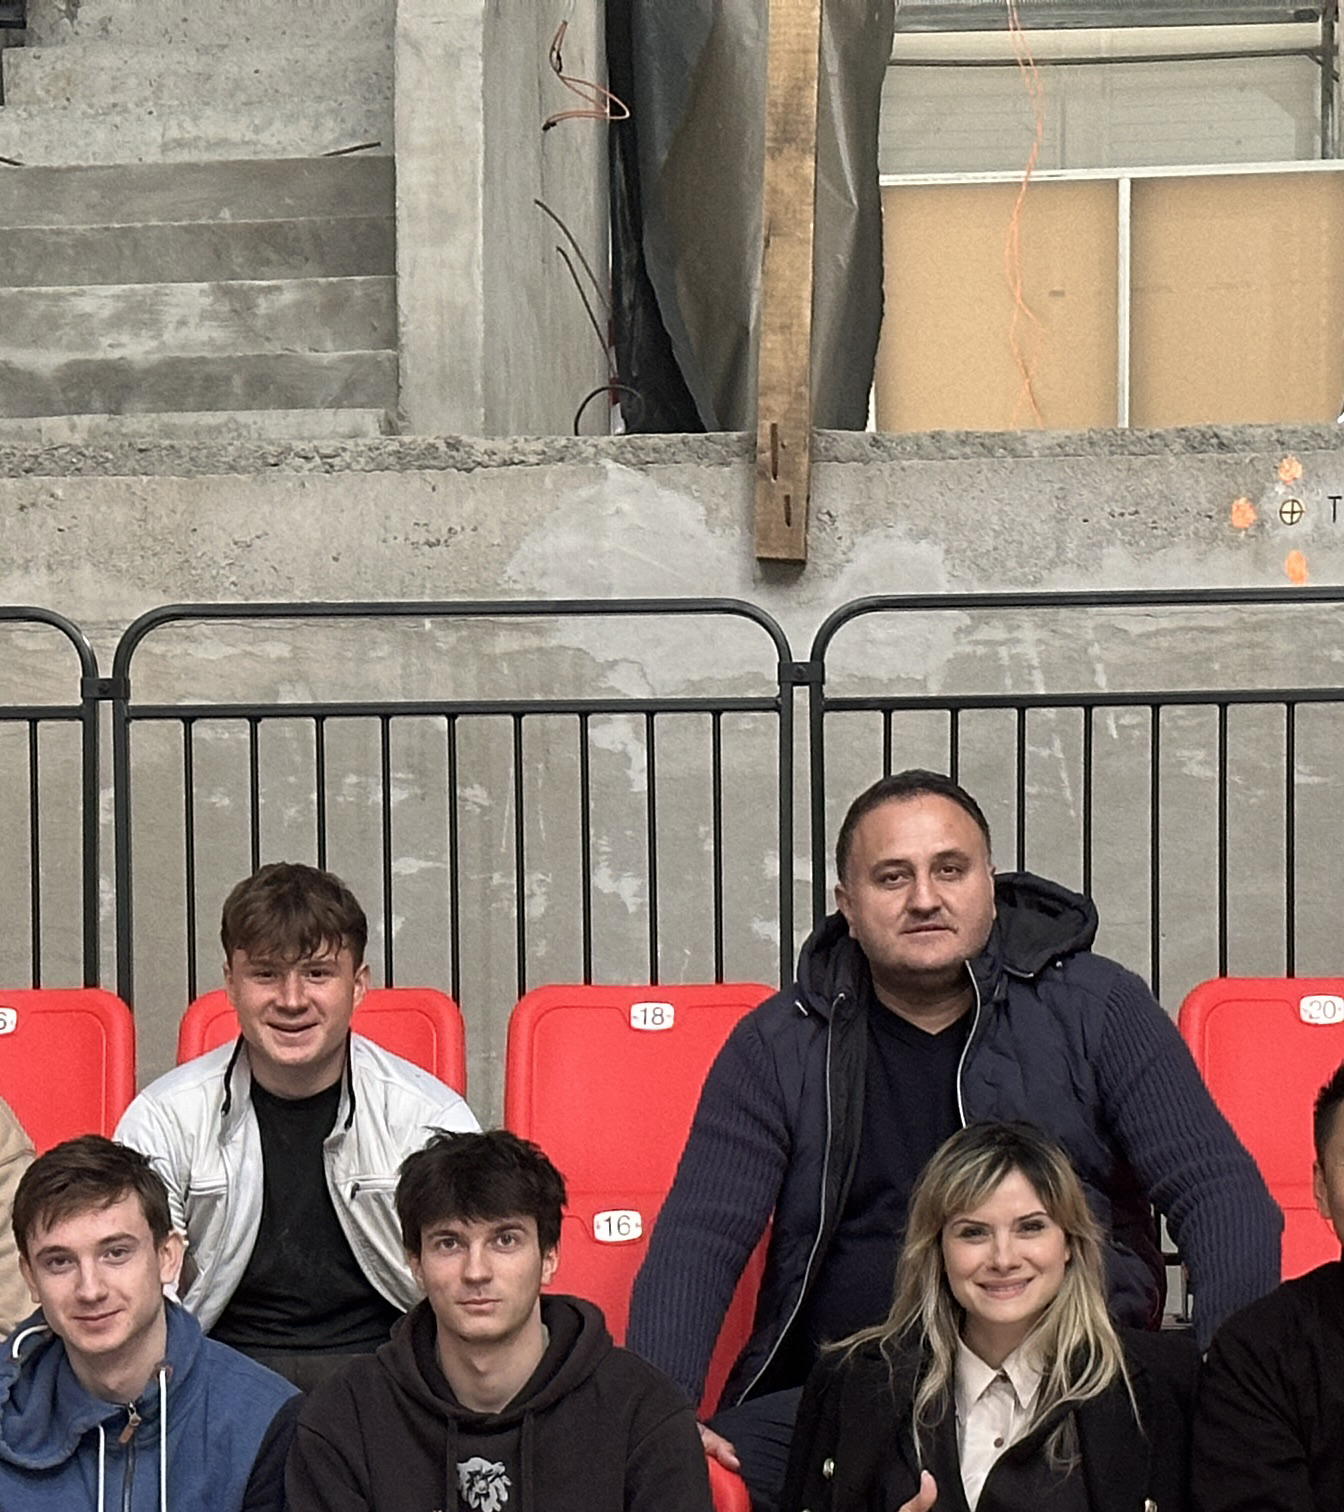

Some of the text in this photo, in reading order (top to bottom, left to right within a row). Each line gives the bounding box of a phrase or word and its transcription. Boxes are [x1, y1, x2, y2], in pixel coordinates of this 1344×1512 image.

[640, 1007, 665, 1026] 18
[1308, 1000, 1337, 1020] 20
[605, 1215, 631, 1237] 16
